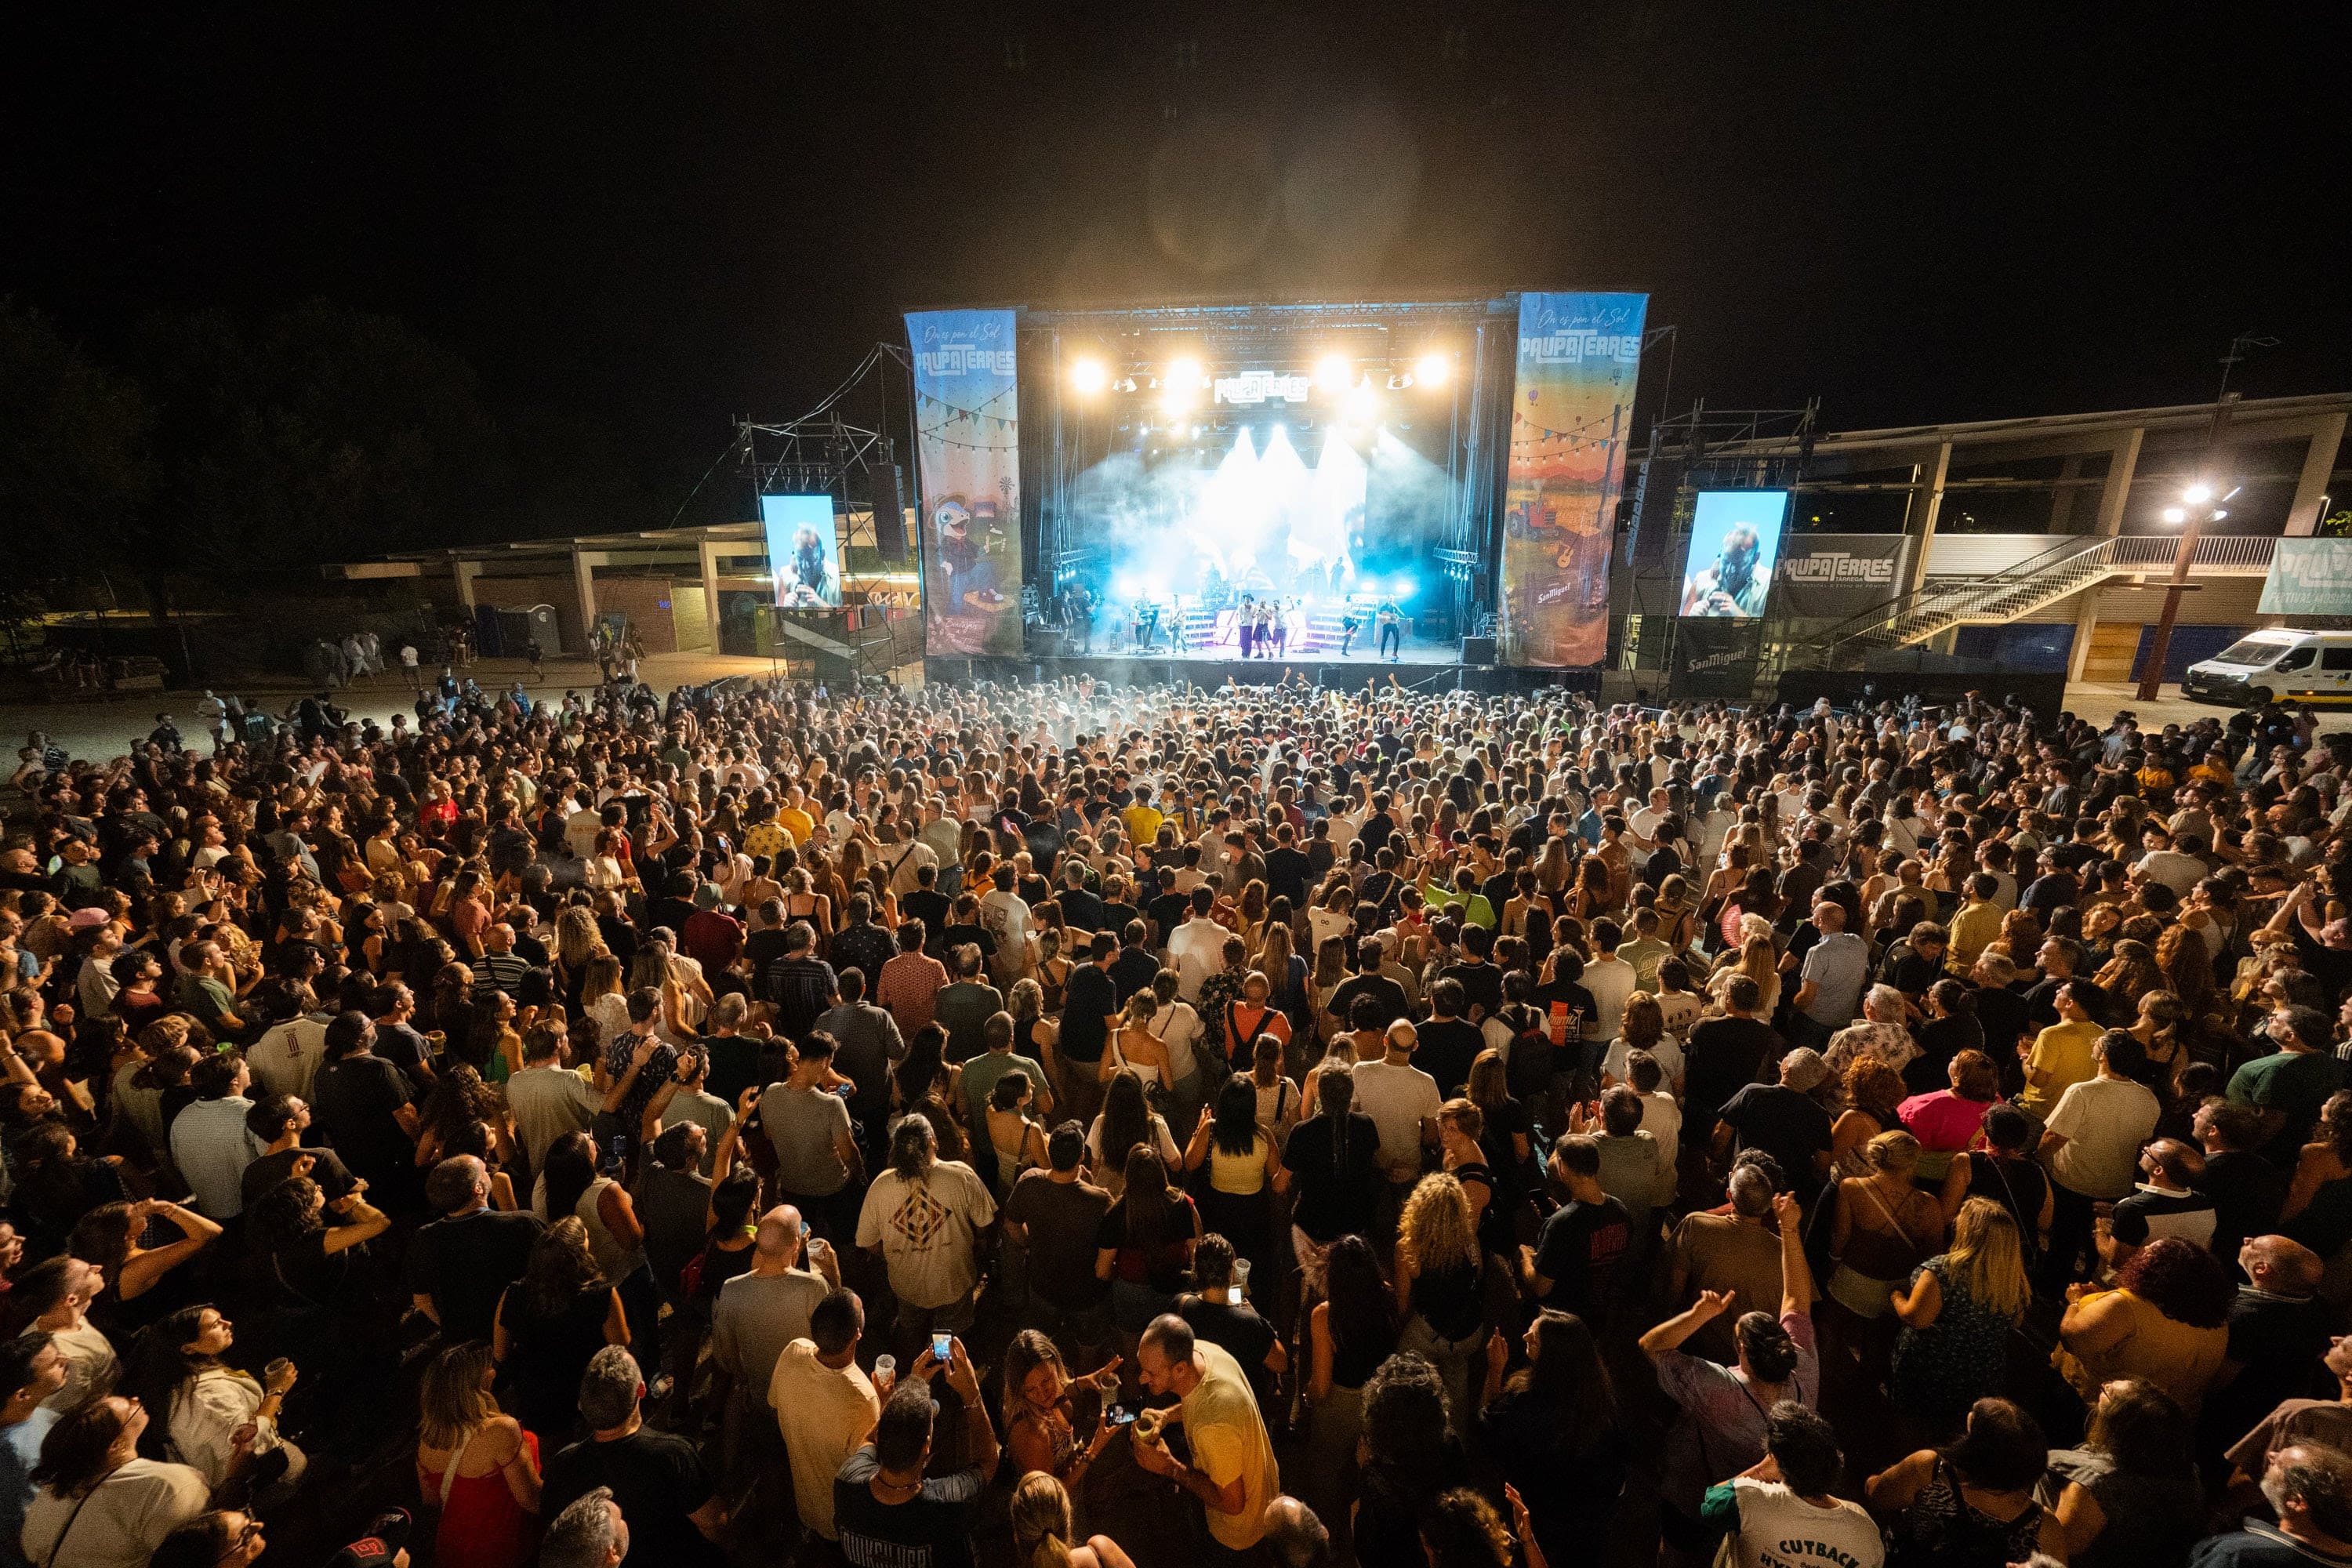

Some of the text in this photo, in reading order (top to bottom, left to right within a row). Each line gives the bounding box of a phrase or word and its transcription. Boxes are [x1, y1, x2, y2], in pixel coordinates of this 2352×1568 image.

[1537, 309, 1556, 328] On
[1605, 307, 1631, 327] Sol
[978, 322, 1003, 342] Sol
[1521, 329, 1640, 364] PAUPATERRES
[1779, 1540, 1860, 1568] CUTBACK
